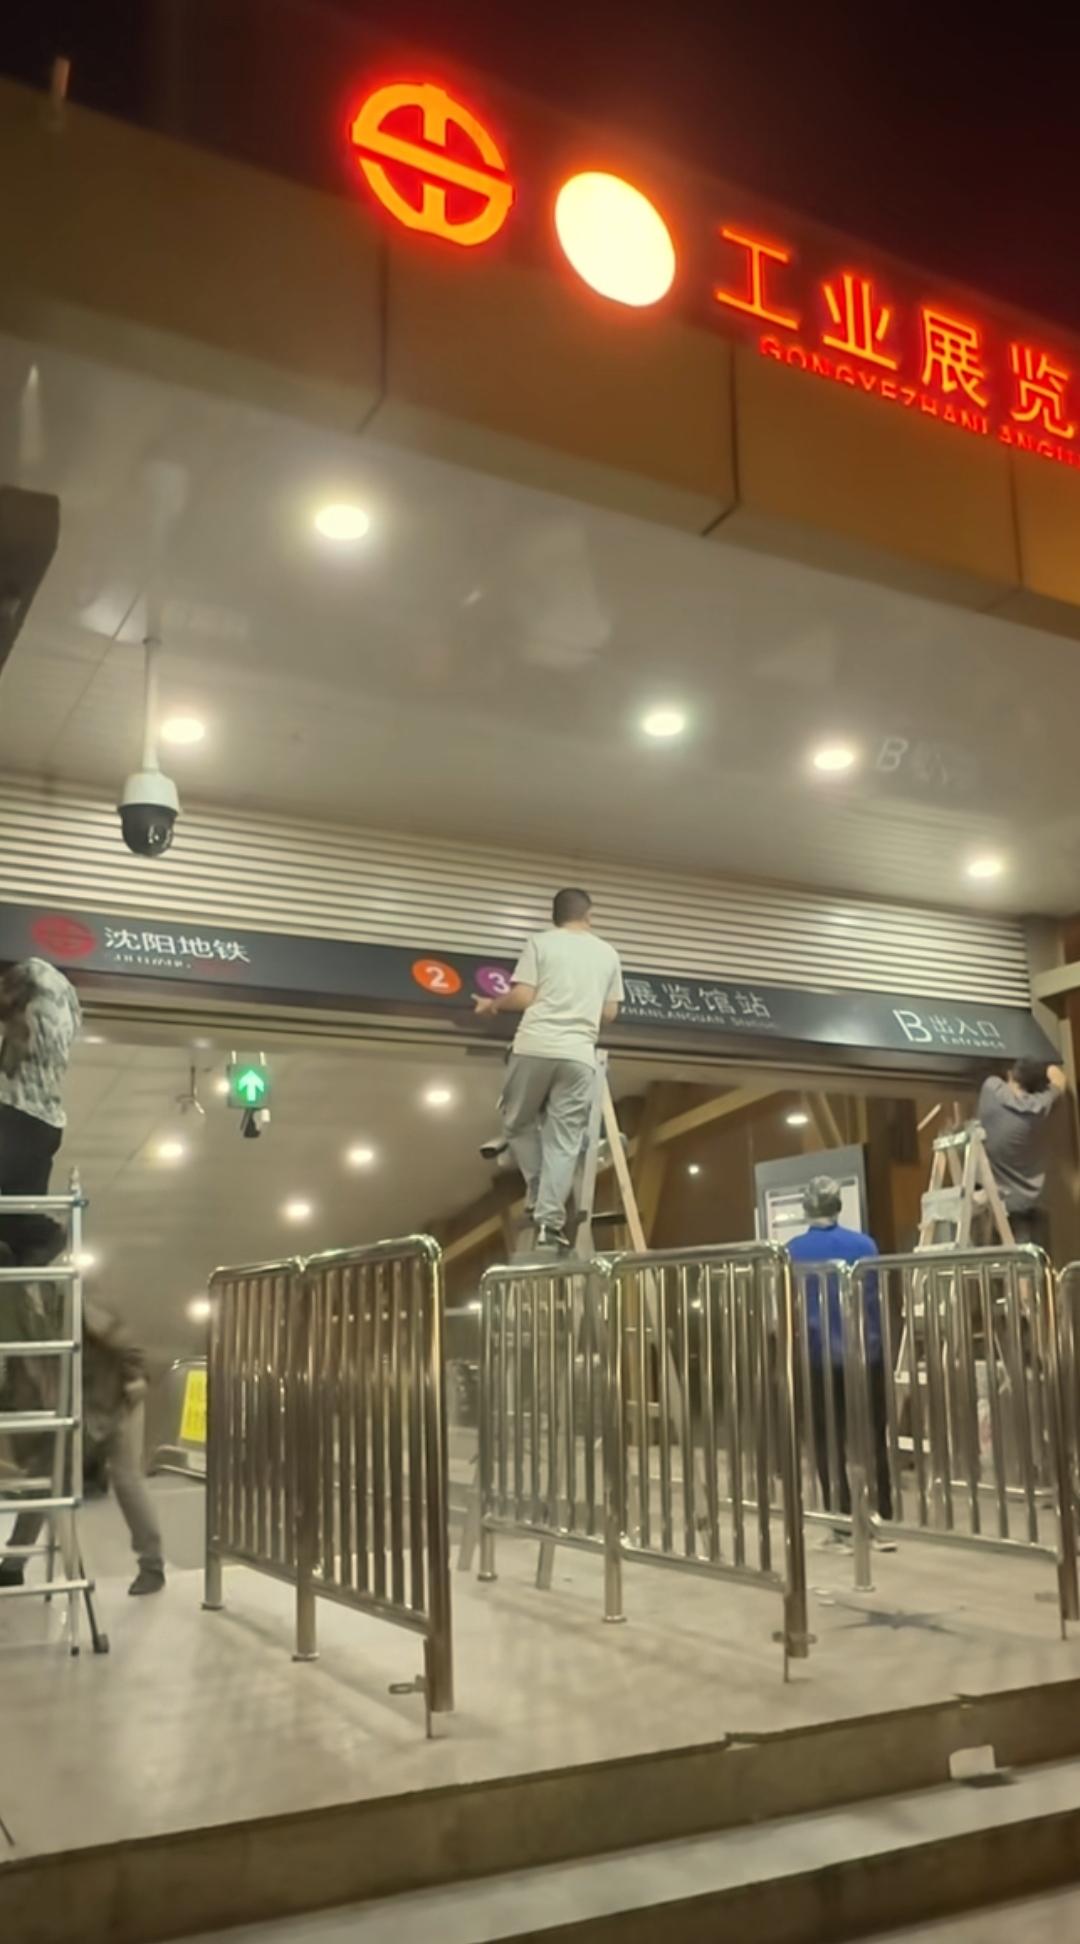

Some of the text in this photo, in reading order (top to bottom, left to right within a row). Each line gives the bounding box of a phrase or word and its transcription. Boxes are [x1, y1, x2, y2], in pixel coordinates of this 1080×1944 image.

[717, 228, 1075, 439] 工业展览
[761, 336, 1080, 470] GONGYEZHANLANGU
[104, 926, 250, 963] 沈阳地铁
[426, 966, 510, 994] 2 3
[624, 979, 770, 1018] 展览馆站
[893, 1009, 933, 1042] B
[929, 1014, 1000, 1038] 出入口
[940, 1034, 1006, 1050] Entrance
